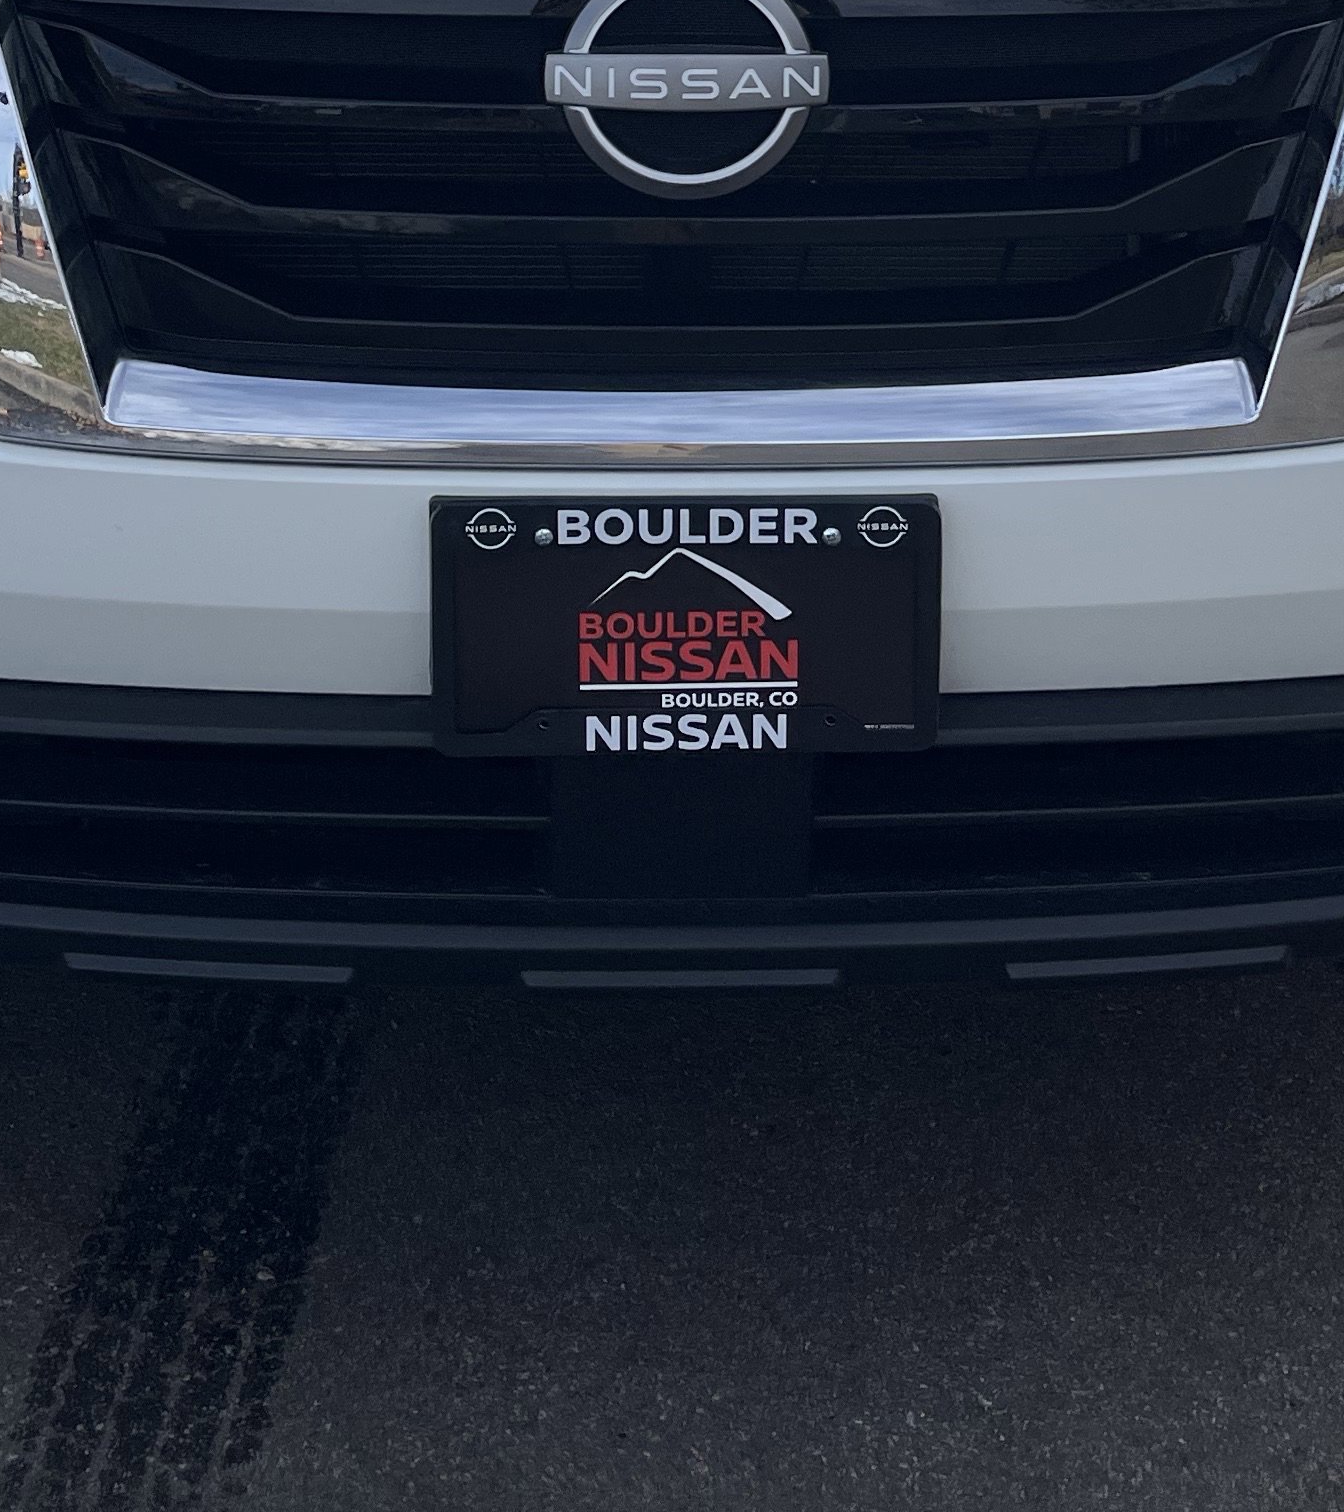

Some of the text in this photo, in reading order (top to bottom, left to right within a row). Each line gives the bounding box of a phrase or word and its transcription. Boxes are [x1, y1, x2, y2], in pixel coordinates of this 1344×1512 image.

[553, 65, 821, 100] NISSAN
[464, 524, 517, 534] NISSAN
[557, 508, 819, 545] BOULDER
[857, 522, 909, 532] NISSAN
[578, 611, 766, 640] BOULDER
[578, 639, 799, 683] NISSAN
[661, 691, 798, 710] BOULDER, CO
[585, 713, 787, 752] NISSAN
